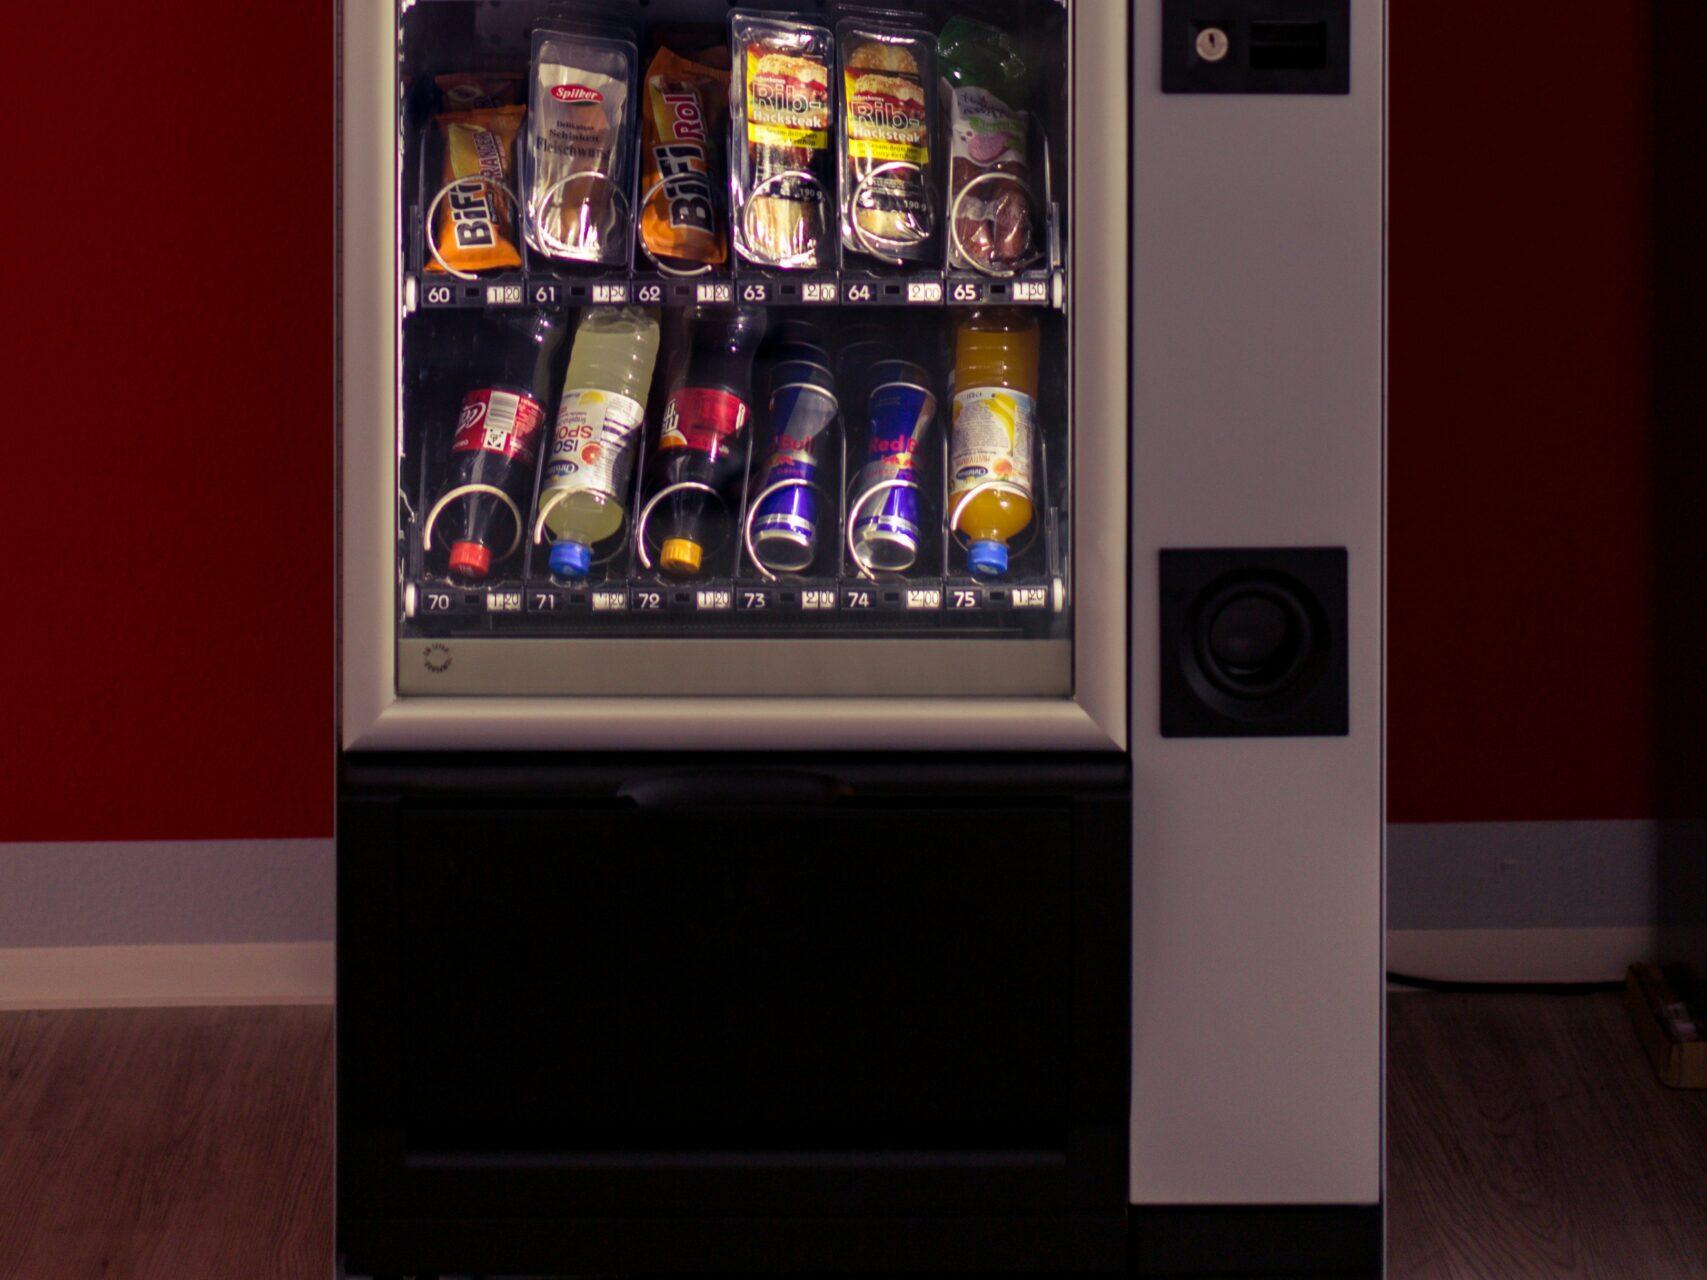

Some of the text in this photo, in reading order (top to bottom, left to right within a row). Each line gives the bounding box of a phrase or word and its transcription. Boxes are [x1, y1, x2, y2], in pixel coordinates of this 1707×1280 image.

[556, 86, 600, 102] Spilker
[752, 81, 823, 116] Rib-
[753, 110, 822, 129] Hacksteak
[851, 101, 922, 131] Rib-
[851, 127, 921, 144] Hacksteak
[428, 287, 450, 303] 60
[536, 286, 555, 302] 61
[638, 285, 661, 301] 62
[743, 284, 766, 301] 63
[848, 285, 870, 301] 64
[954, 284, 976, 301] 65
[428, 594, 450, 609] 70
[536, 594, 554, 609] 71
[638, 593, 660, 608] 72
[744, 592, 765, 607] 73
[848, 592, 869, 607] 74
[953, 591, 976, 607] 75
